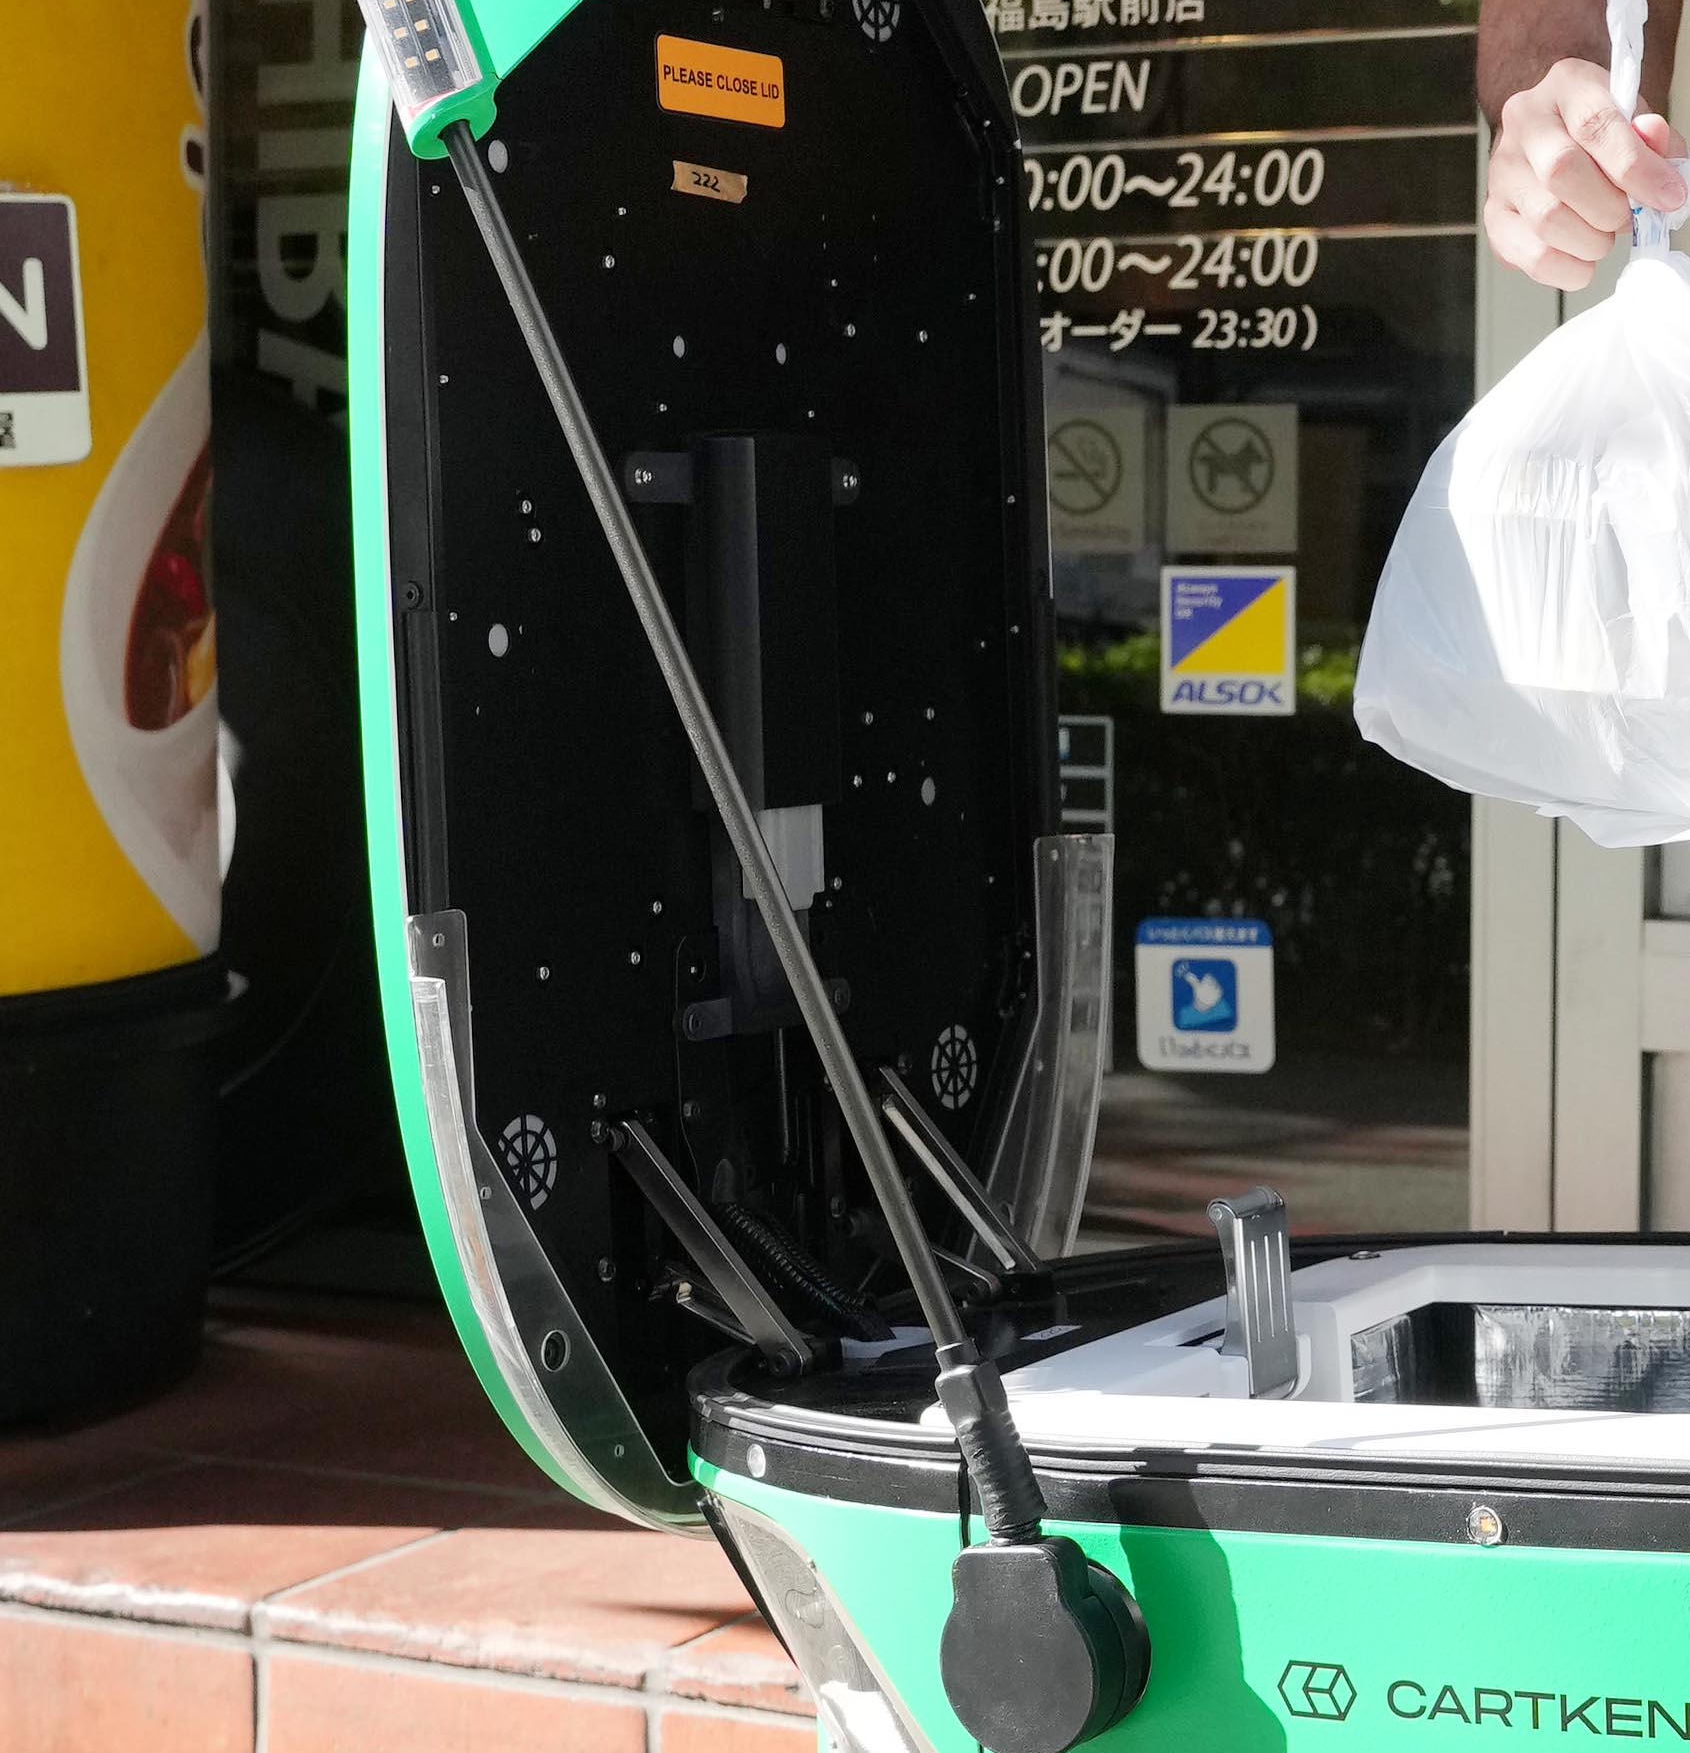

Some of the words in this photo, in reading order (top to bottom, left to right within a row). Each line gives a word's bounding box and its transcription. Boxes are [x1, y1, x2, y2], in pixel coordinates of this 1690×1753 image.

[663, 64, 713, 88] PLEASE
[716, 74, 758, 96] CLOSE
[761, 82, 779, 99] LID
[1012, 59, 1150, 118] OPEN
[1171, 679, 1284, 706] ALSOK
